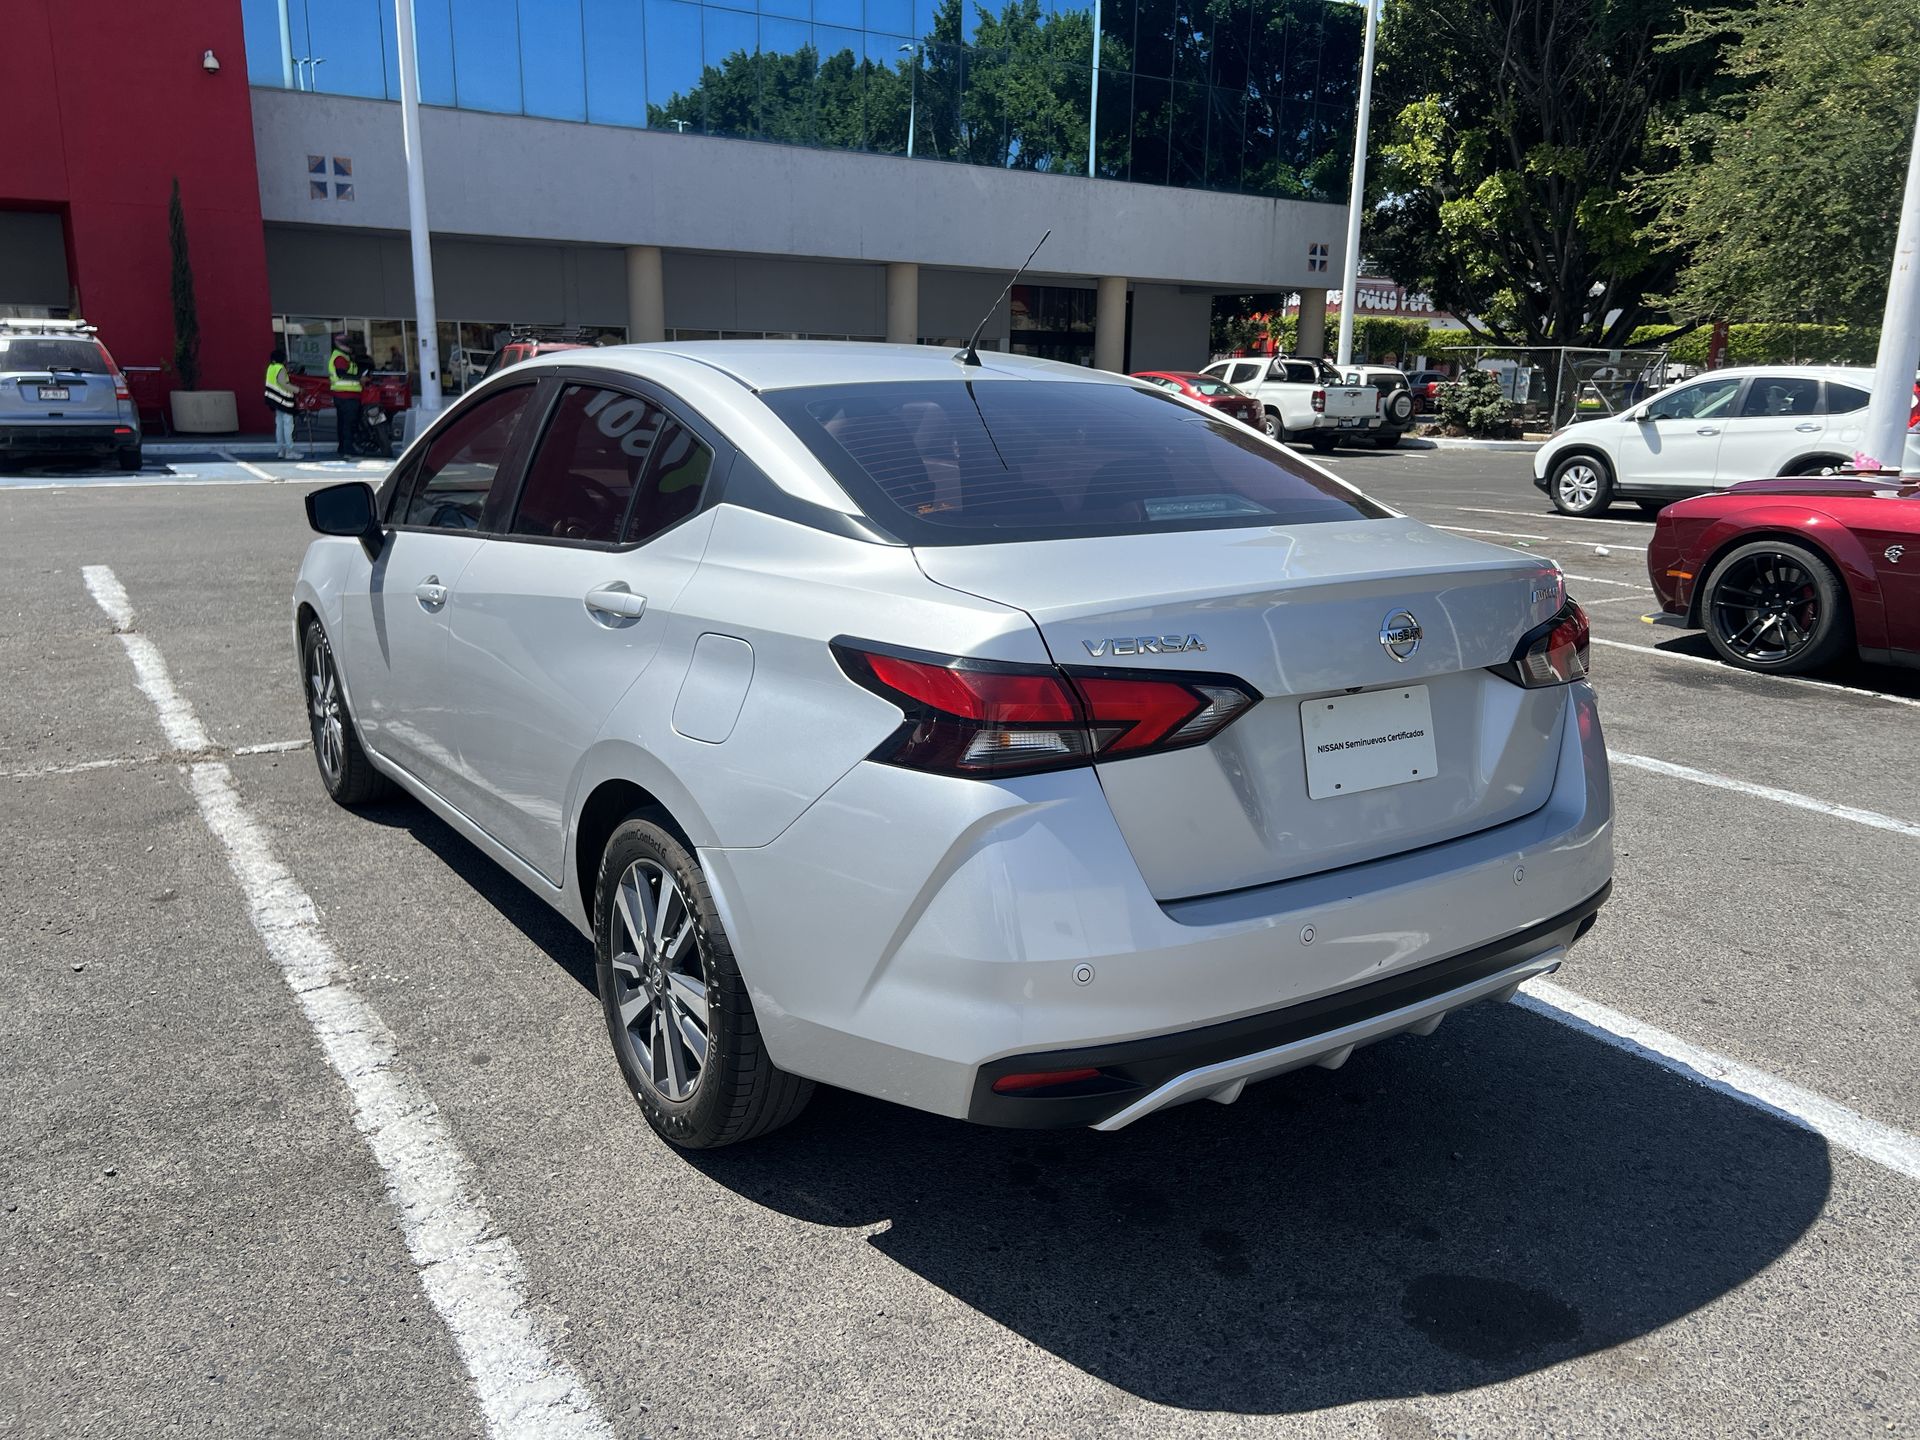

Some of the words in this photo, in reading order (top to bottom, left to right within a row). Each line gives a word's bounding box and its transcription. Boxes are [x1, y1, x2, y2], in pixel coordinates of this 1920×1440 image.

[1081, 633, 1207, 657] VERSA
[1387, 628, 1422, 642] NISSAN
[1317, 742, 1345, 753] NISSAN
[1346, 736, 1386, 749] Seminuevos
[1387, 730, 1424, 741] Certificados
